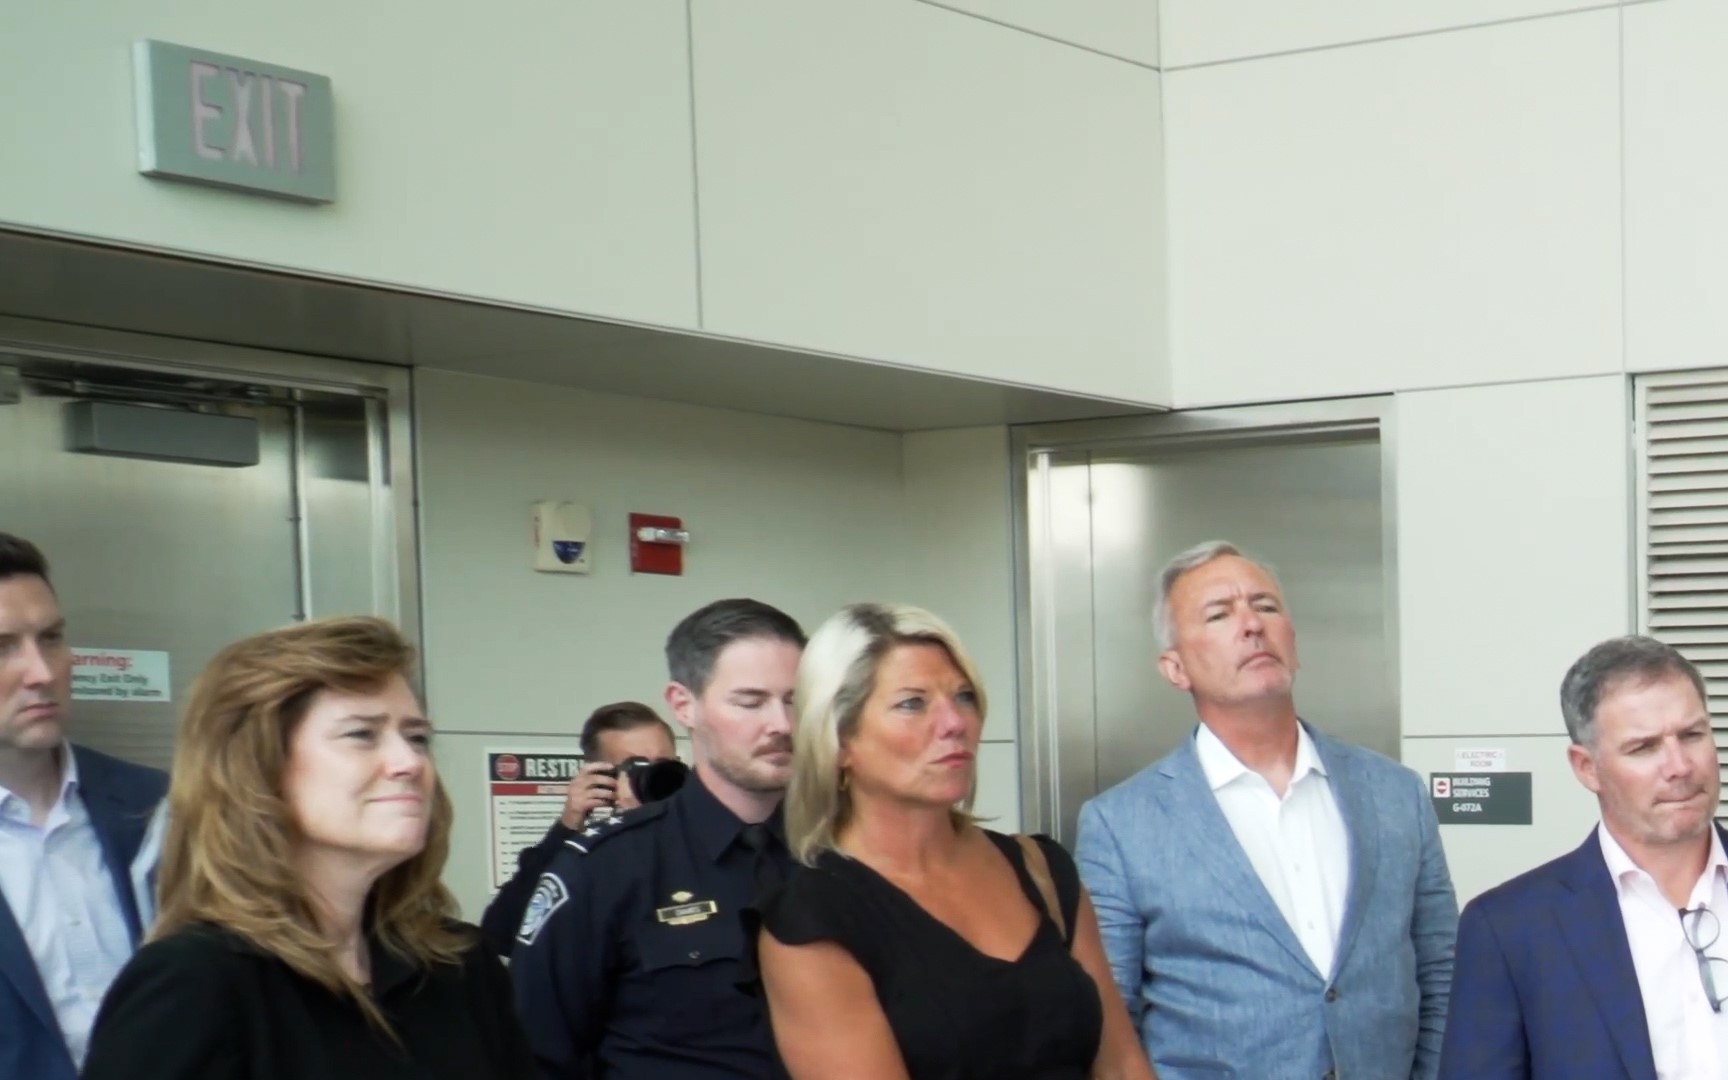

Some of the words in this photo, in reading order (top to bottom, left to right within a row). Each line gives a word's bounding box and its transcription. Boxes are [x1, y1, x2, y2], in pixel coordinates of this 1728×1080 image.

[189, 58, 307, 176] EXIT
[71, 653, 132, 671] arning:
[1452, 787, 1490, 798] SERVICES
